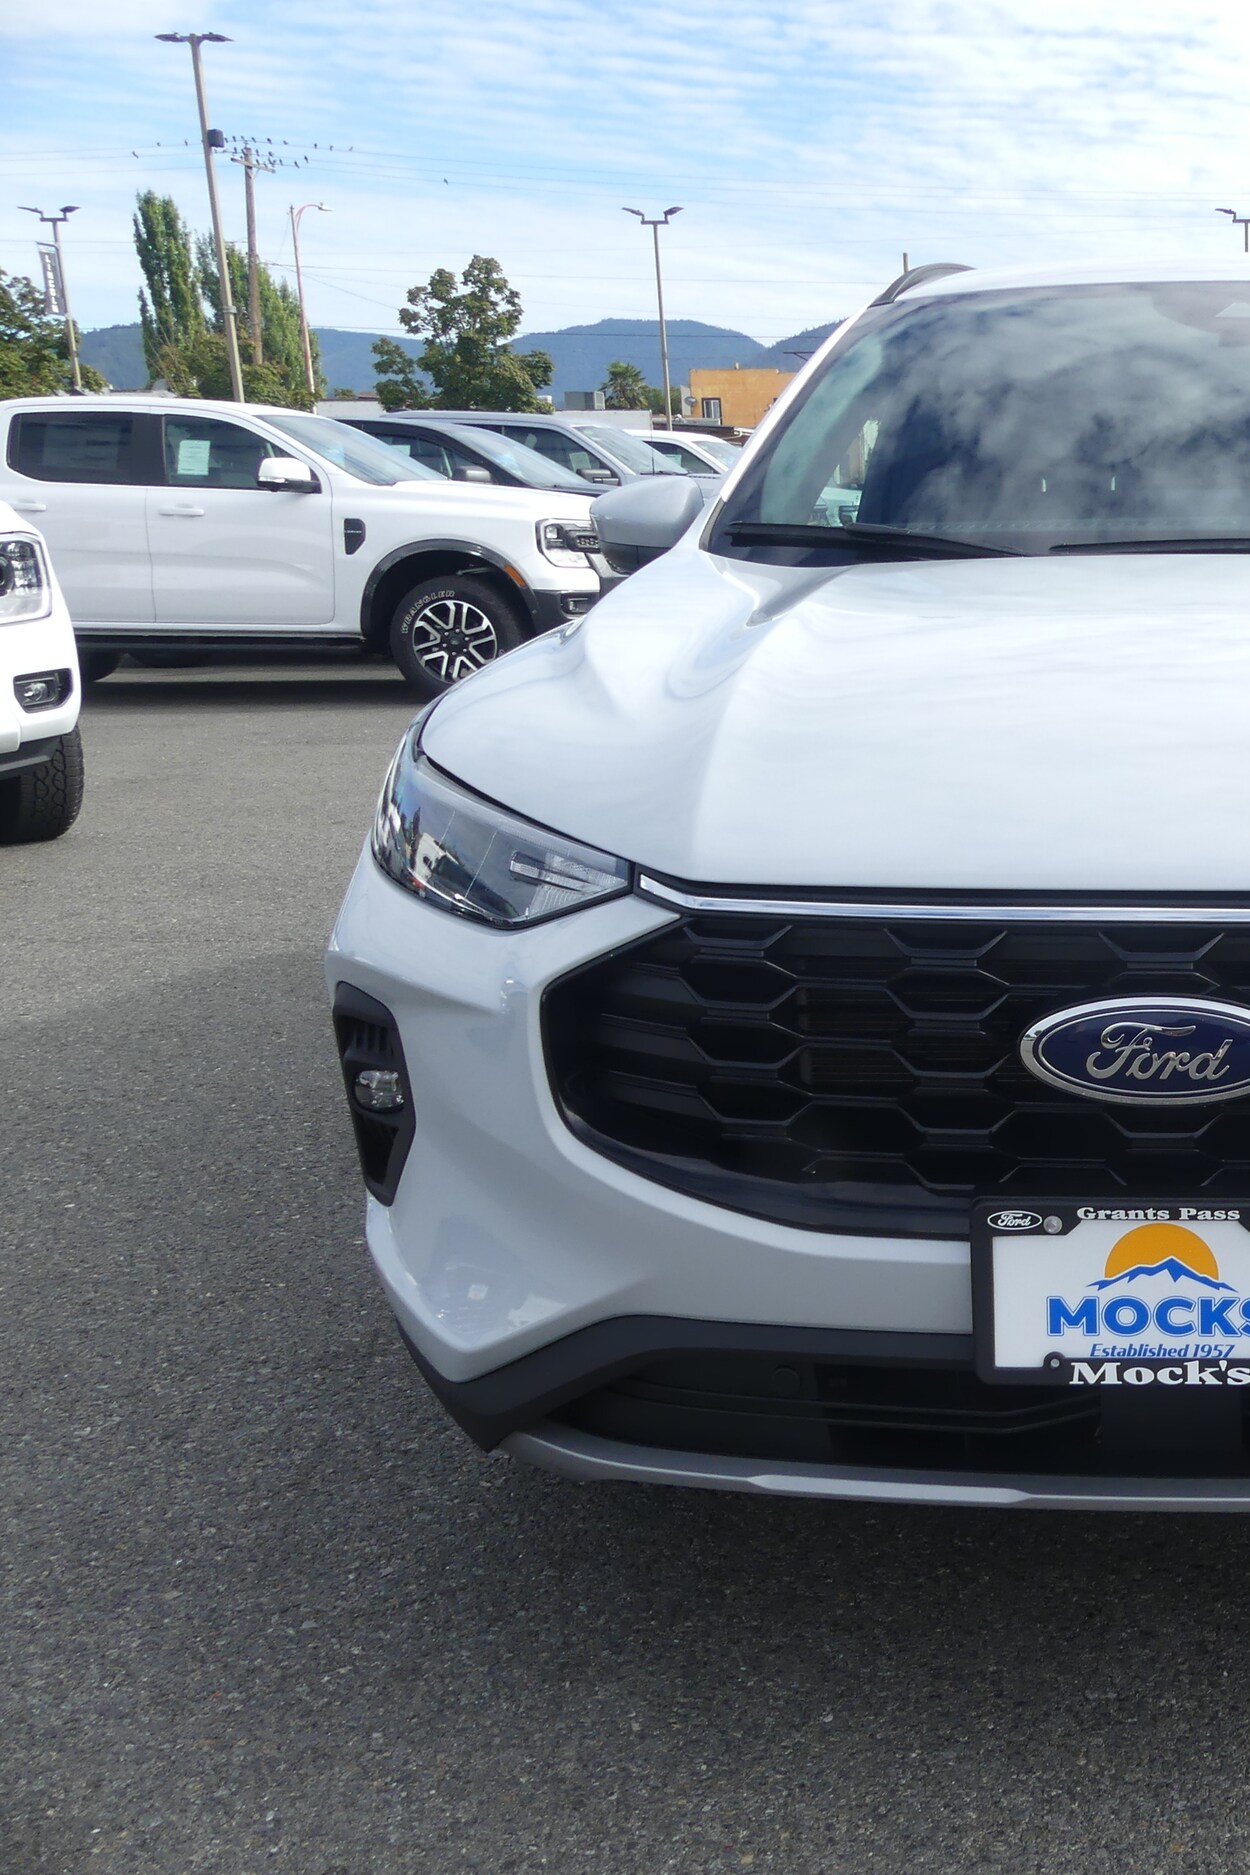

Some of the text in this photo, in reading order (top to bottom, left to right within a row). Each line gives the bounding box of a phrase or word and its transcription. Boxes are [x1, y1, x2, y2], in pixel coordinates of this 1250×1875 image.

[44, 254, 60, 313] LINCOLN
[400, 590, 456, 635] WRANGLER
[1086, 1021, 1233, 1081] Ford
[997, 1212, 1032, 1229] Ford
[1076, 1206, 1241, 1221] Grants Pass
[1089, 1343, 1236, 1359] Established 1957
